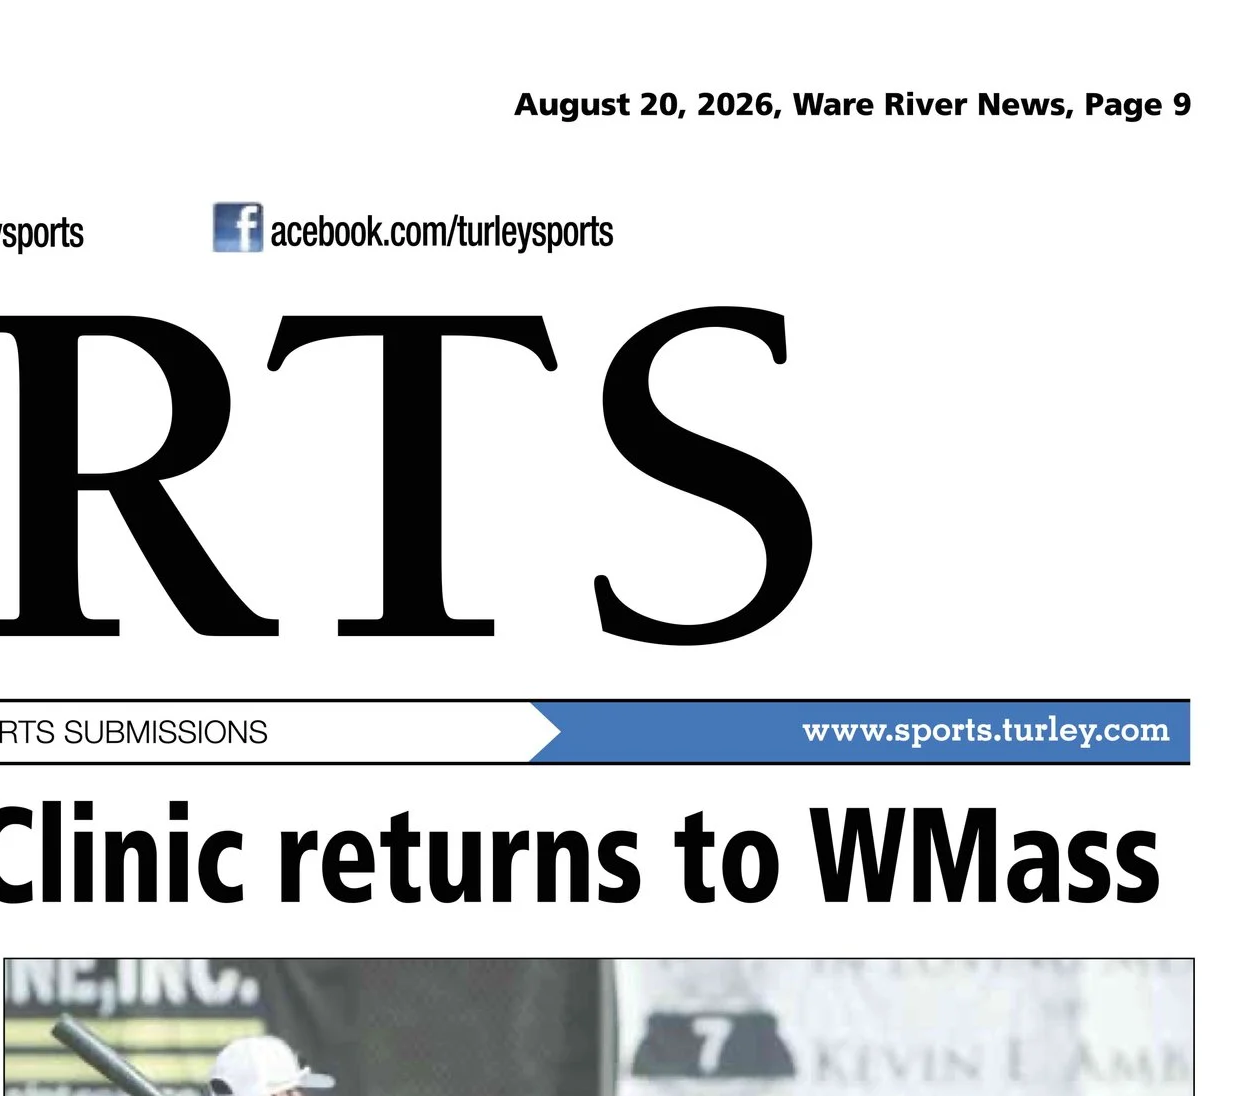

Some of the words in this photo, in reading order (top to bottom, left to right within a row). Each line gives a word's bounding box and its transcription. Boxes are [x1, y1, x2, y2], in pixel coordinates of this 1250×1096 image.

[513, 92, 631, 123] August
[640, 92, 686, 120] 20,
[697, 92, 782, 120] 2026,
[792, 92, 875, 117] Ware
[885, 91, 968, 116] River
[978, 92, 1074, 120] News,
[1085, 92, 1163, 123] Page
[1173, 92, 1192, 116] 9
[64, 719, 268, 745] SUBMISSIONS
[802, 715, 1170, 749] www.sports.turley.com
[280, 810, 641, 904] returns
[674, 810, 779, 904] to
[809, 807, 1159, 904] WMass
[690, 1016, 736, 1077] 7
